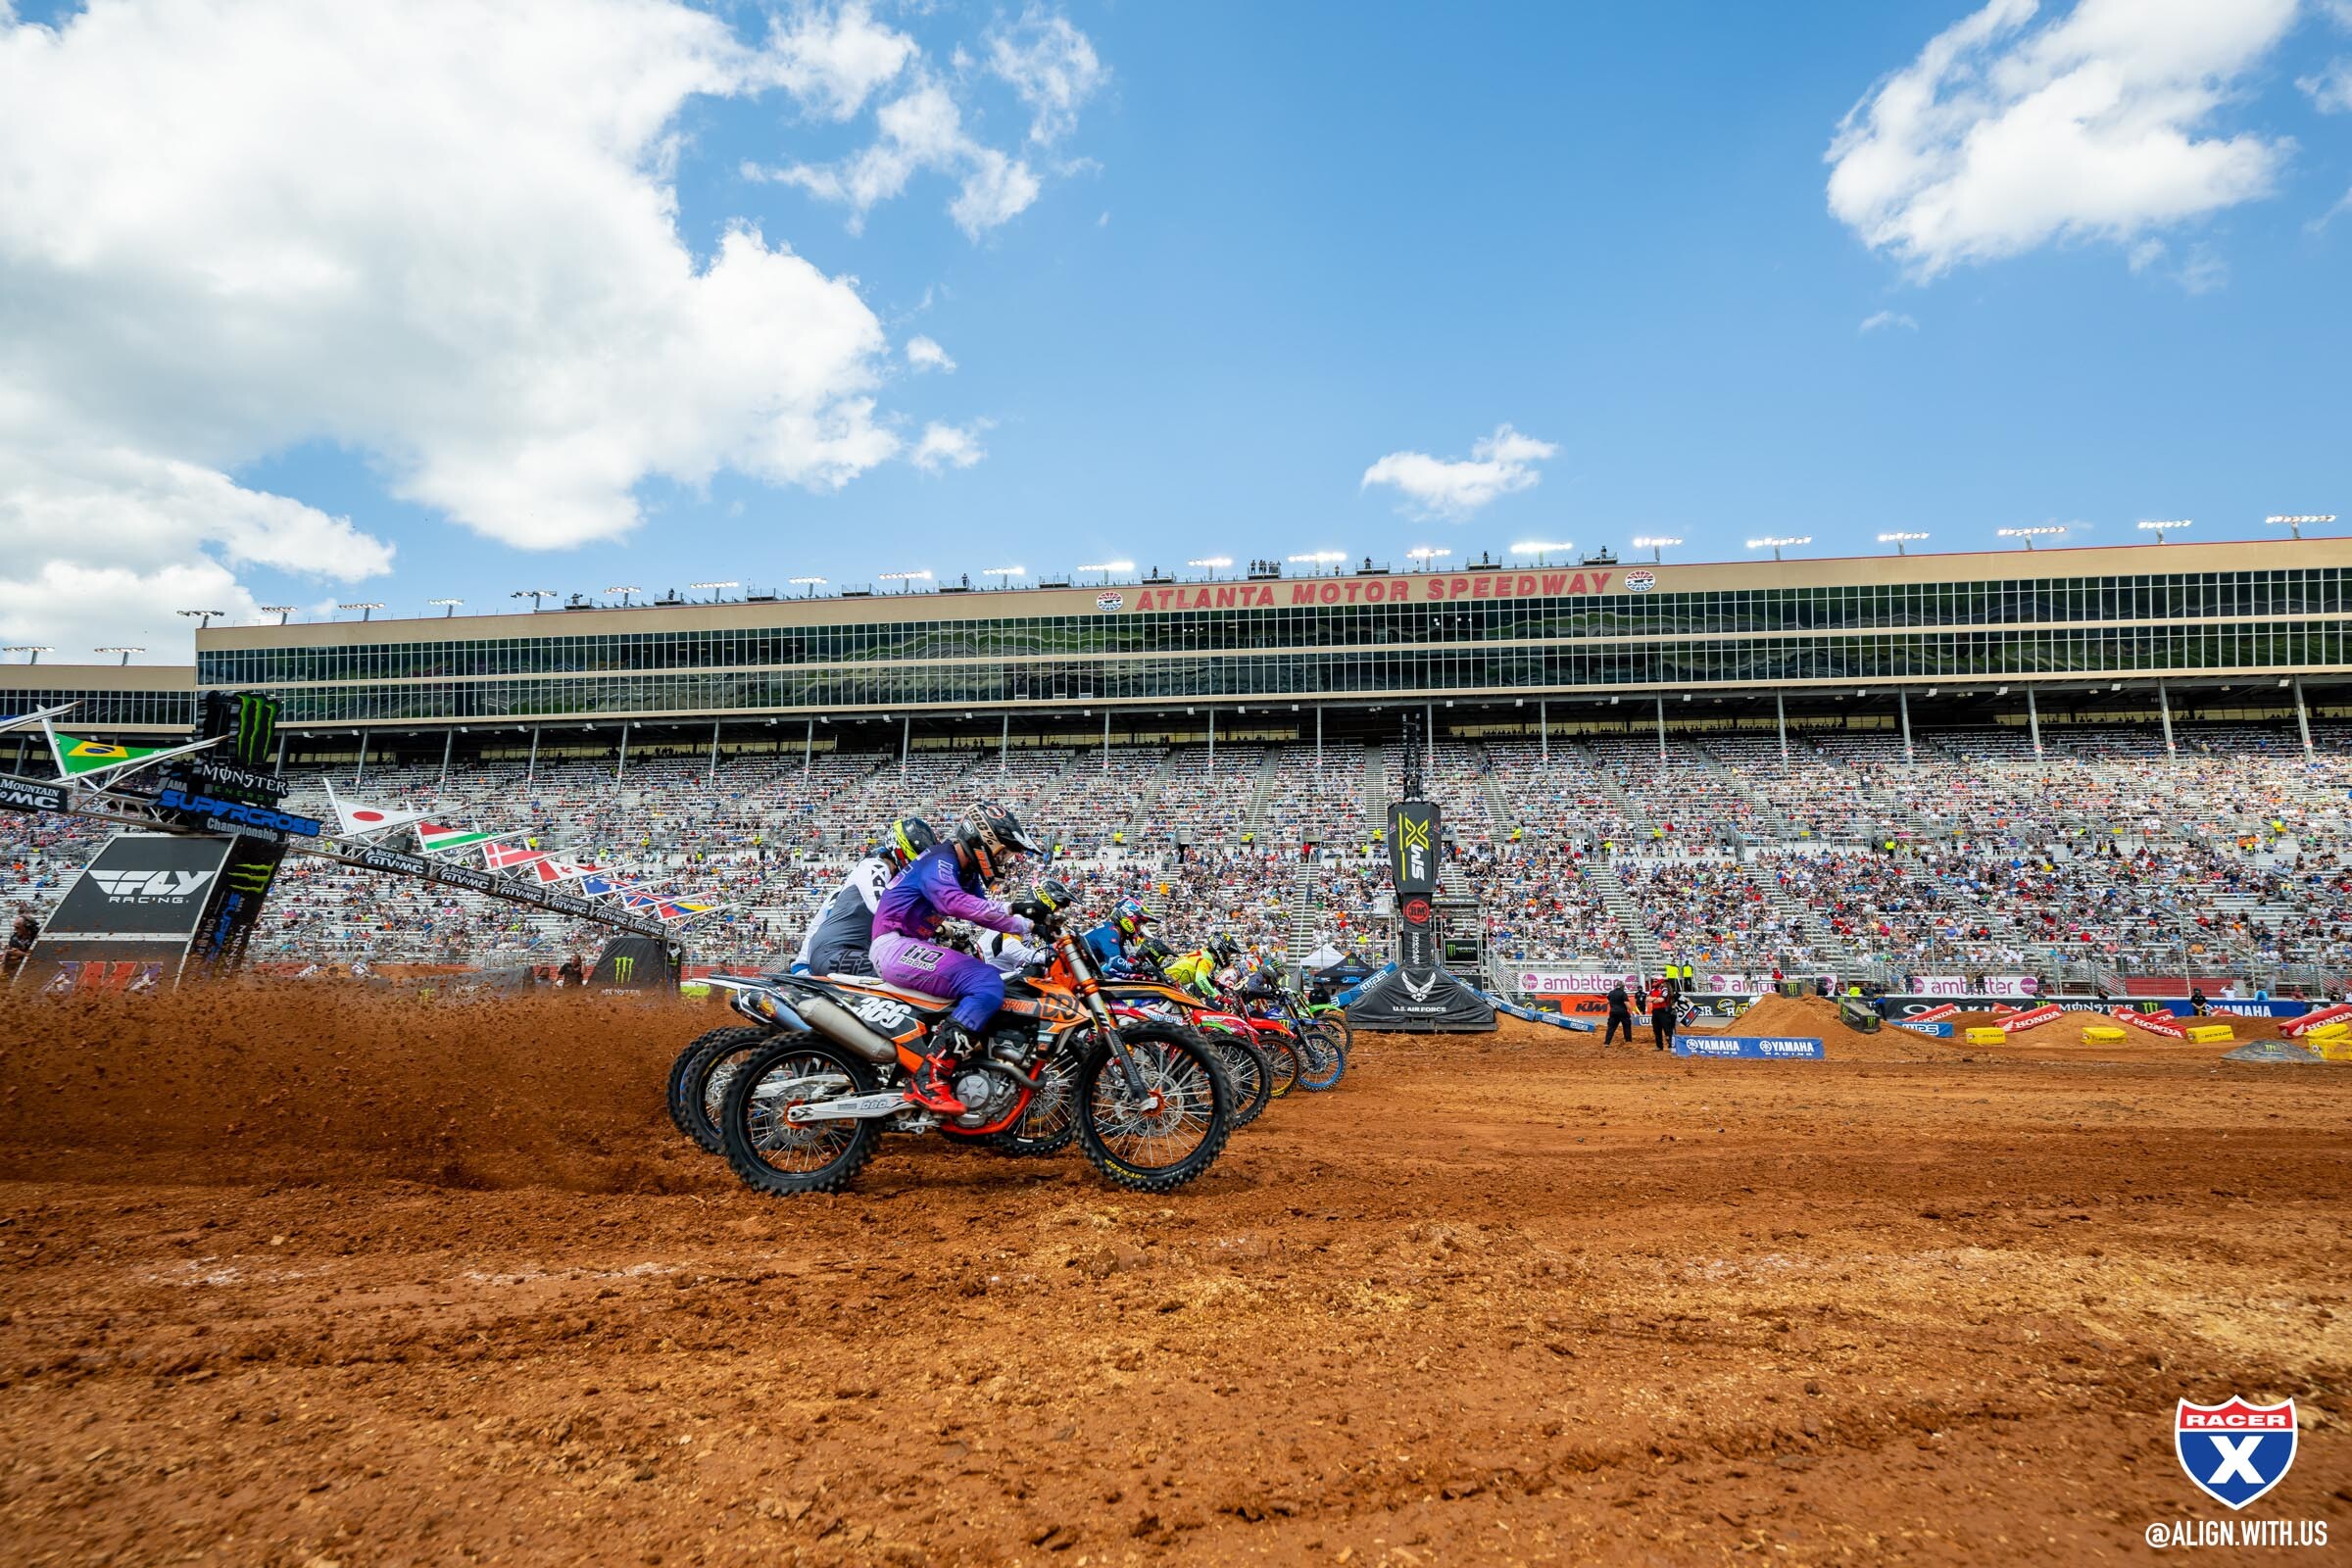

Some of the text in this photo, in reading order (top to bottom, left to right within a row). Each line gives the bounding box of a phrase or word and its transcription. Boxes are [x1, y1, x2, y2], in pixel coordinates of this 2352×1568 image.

[1135, 571, 1612, 611] ATLANTA MOTOR SPEEDWAY
[1, 778, 60, 797] MOUNTAIN
[167, 779, 188, 792] AMA
[203, 764, 288, 796] MONSTER
[206, 817, 278, 843] Championship
[375, 848, 424, 866] ROCKY MOUNTAIN
[88, 869, 217, 896] FLY
[108, 896, 185, 905] RACING
[899, 956, 936, 971] RACING
[853, 998, 911, 1029] 366
[1575, 1002, 1608, 1012] KTM
[2016, 1011, 2061, 1029] HONDA
[2132, 1017, 2183, 1039] HONDA
[1697, 1039, 1740, 1052] YAMAHA
[1771, 1041, 1815, 1053] YAMAHA
